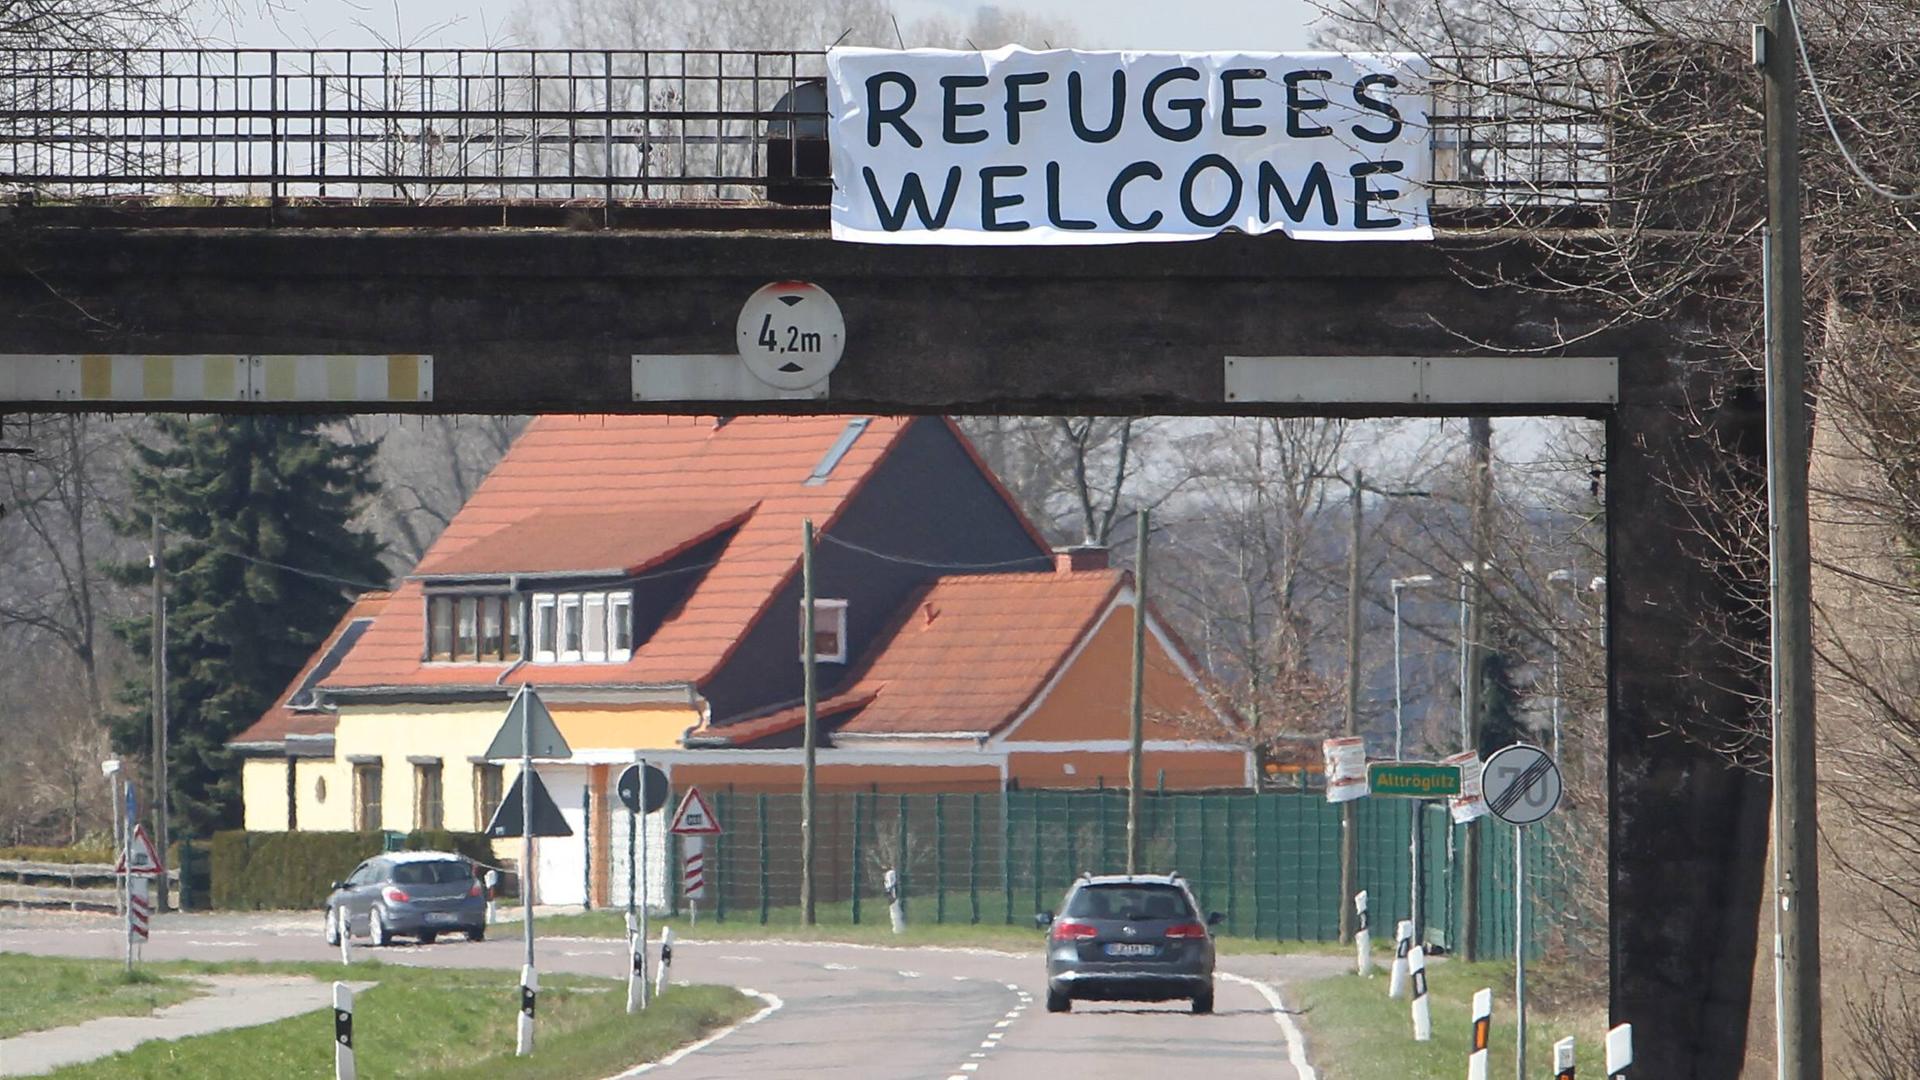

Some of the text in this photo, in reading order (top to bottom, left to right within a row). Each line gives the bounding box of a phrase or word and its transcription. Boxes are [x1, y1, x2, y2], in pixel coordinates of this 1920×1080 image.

[865, 67, 1403, 148] REFUGEES
[863, 153, 1403, 231] WELCOME
[758, 313, 821, 354] 4,2m
[1377, 772, 1456, 791] Alttröglitz
[1498, 767, 1548, 807] 70
